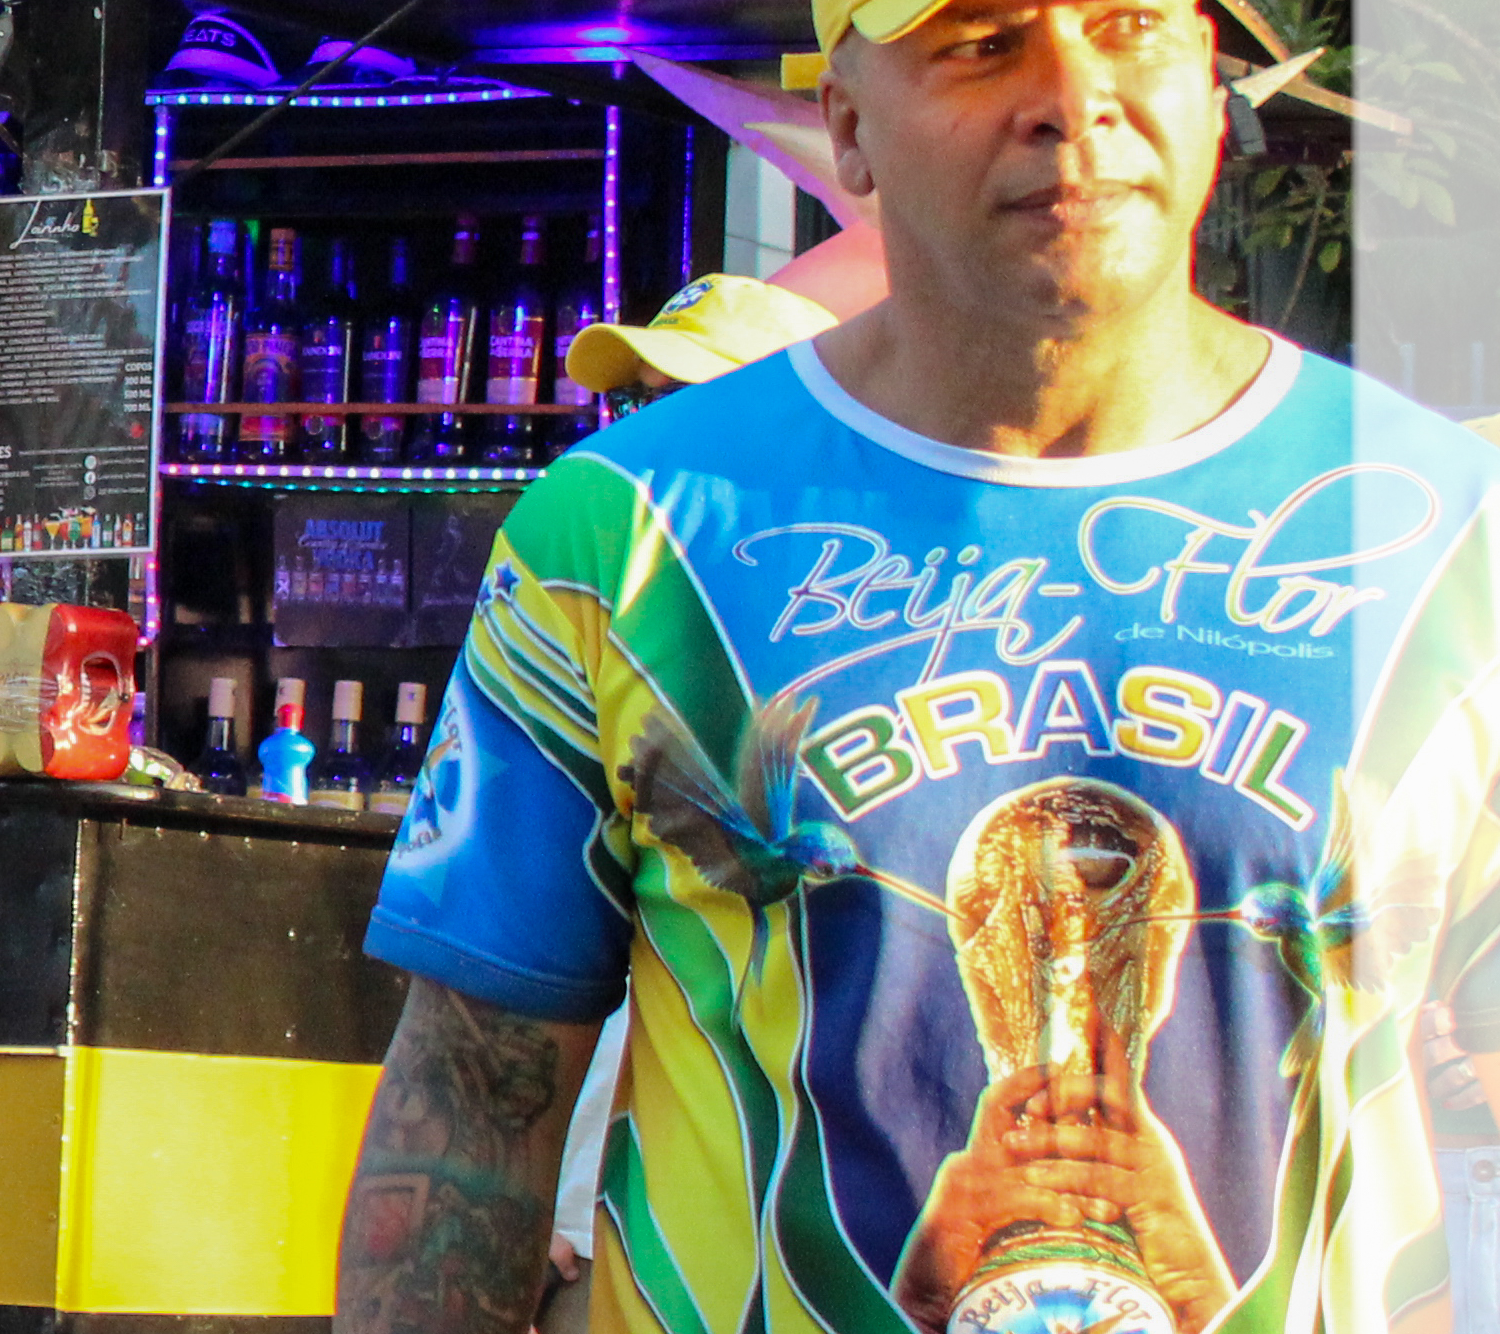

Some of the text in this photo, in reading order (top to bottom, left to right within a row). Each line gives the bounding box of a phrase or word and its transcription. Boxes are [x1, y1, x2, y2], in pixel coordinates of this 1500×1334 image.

[184, 28, 237, 48] EATS
[124, 361, 153, 372] COPOS
[1114, 622, 1335, 661] de Nilópolis
[800, 658, 1315, 833] BRASIL
